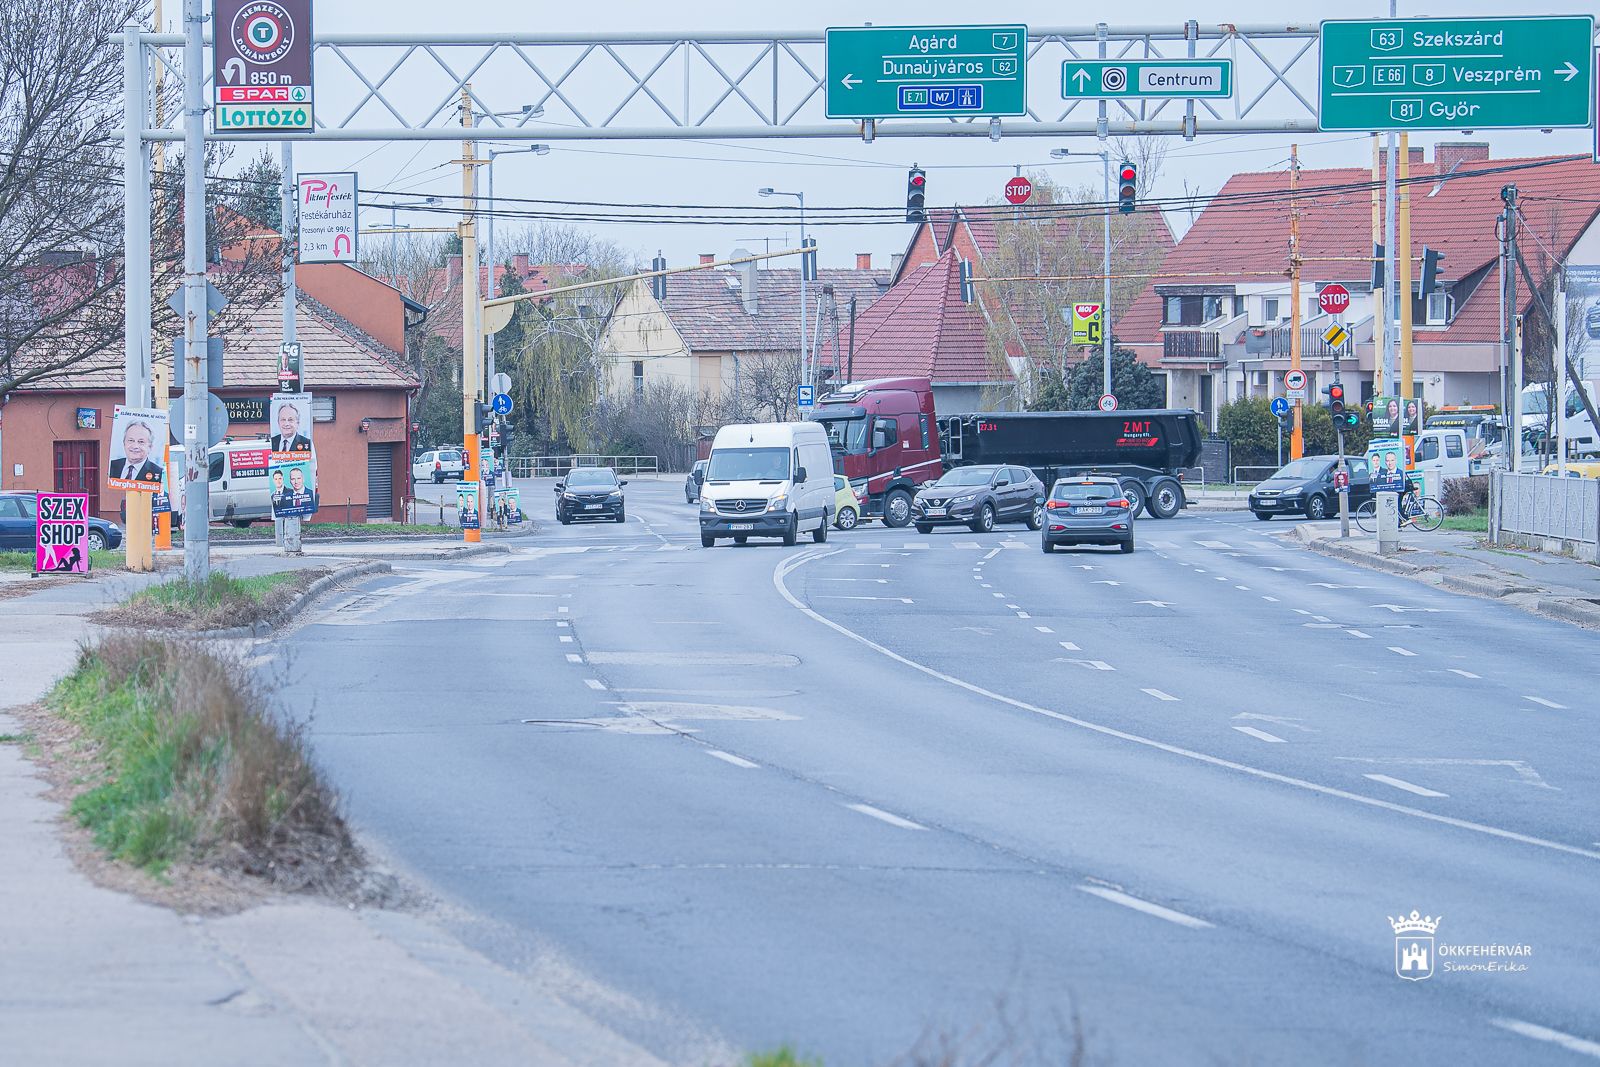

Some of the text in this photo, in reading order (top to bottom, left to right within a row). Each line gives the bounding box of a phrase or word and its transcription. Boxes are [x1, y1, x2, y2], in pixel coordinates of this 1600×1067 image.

[242, 4, 283, 20] NEMZETI
[258, 28, 268, 38] T
[1413, 30, 1503, 46] Szekszárd
[908, 34, 957, 53] Agárd
[1002, 36, 1008, 46] 7
[1379, 33, 1395, 46] 63
[236, 38, 290, 60] DOHÁNYBOLT
[883, 60, 983, 77] Dunaújváros
[999, 62, 1011, 72] 62
[250, 72, 292, 85] 850 m
[1148, 73, 1212, 86] Centrum
[1345, 70, 1353, 82] 7
[1378, 69, 1400, 82] E 66
[1426, 69, 1434, 81] 8
[1453, 66, 1541, 85] Veszprém
[232, 90, 288, 99] SPAR
[908, 92, 923, 102] E 71
[936, 92, 949, 102] M7
[1400, 104, 1413, 116] 81
[222, 108, 306, 126] LOTTÓZÓ
[1006, 185, 1030, 196] STOP
[302, 210, 352, 219] Festékáruház
[304, 243, 314, 252] 2,3
[1320, 294, 1348, 305] STOP
[224, 400, 262, 410] MUSKÁTLI
[110, 480, 136, 488] Vargha
[40, 498, 84, 520] SZEX
[41, 524, 85, 545] SHOP
